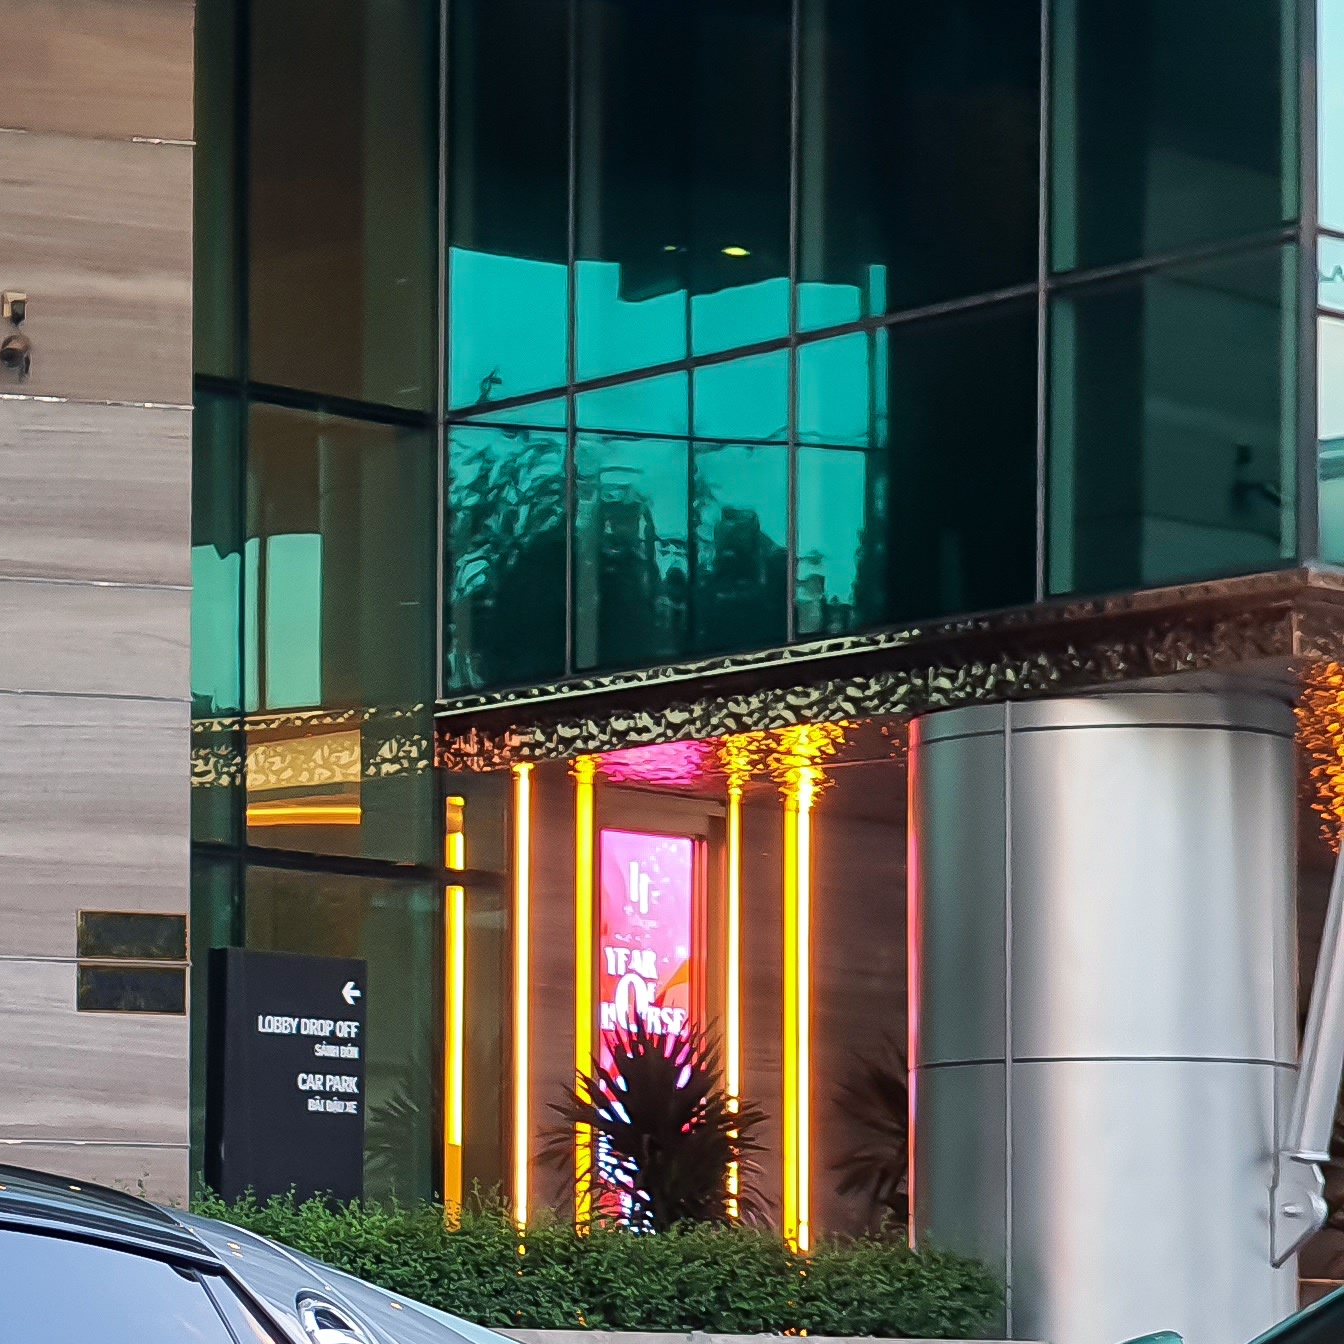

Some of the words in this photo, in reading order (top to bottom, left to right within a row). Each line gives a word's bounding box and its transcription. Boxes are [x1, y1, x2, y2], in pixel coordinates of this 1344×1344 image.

[258, 1015, 299, 1034] LOBBY
[300, 1018, 334, 1037] DROP
[335, 1021, 360, 1038] OFF
[297, 1073, 324, 1090] CAR
[325, 1075, 359, 1093] PARK
